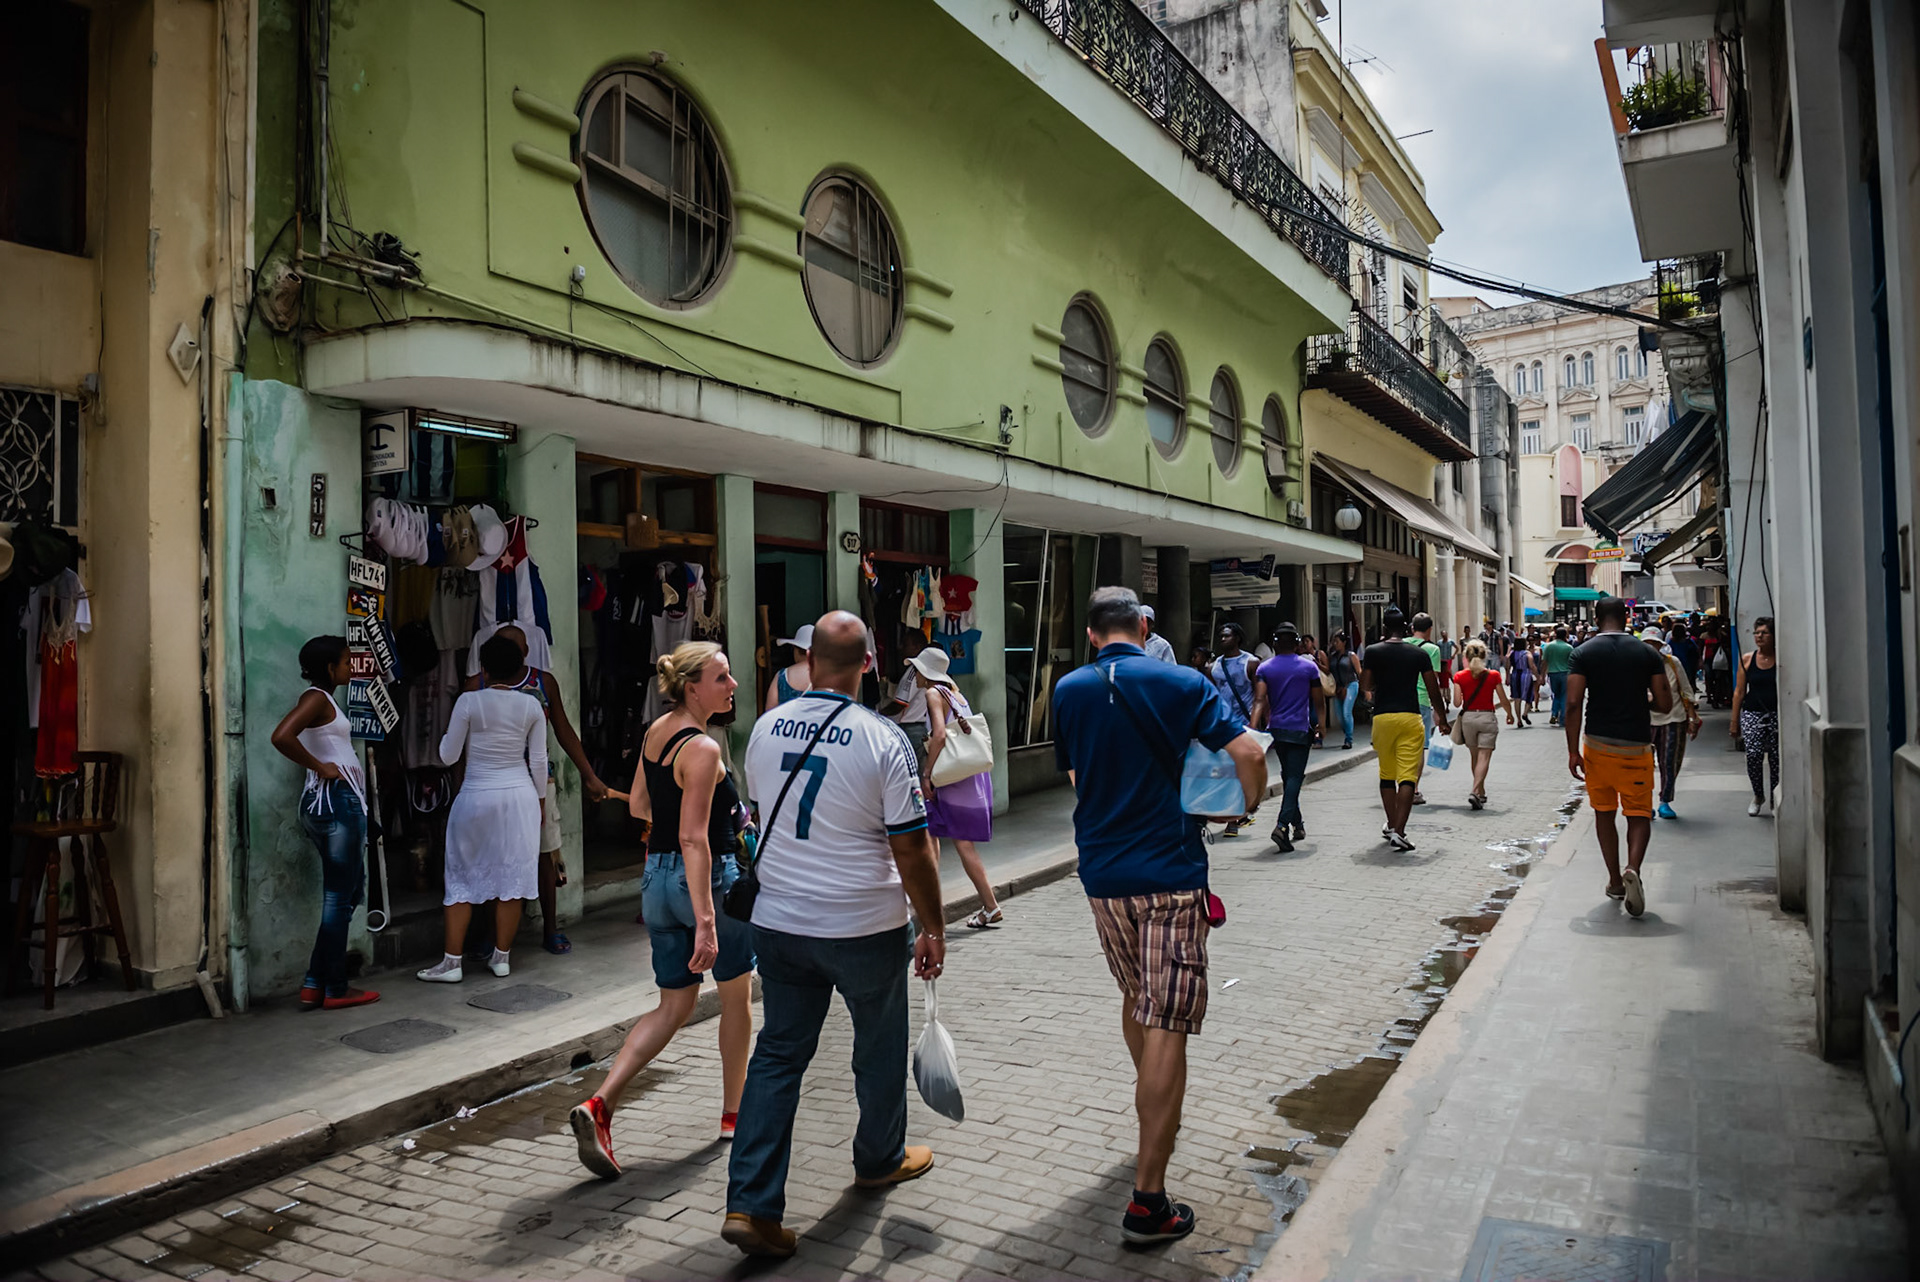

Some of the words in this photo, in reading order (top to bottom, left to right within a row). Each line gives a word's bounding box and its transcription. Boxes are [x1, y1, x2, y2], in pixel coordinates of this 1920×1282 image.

[313, 475, 324, 536] 517
[351, 561, 385, 586] HFL741
[367, 616, 393, 669] HABANA
[370, 680, 397, 728] HABANA
[780, 752, 828, 840] 7
